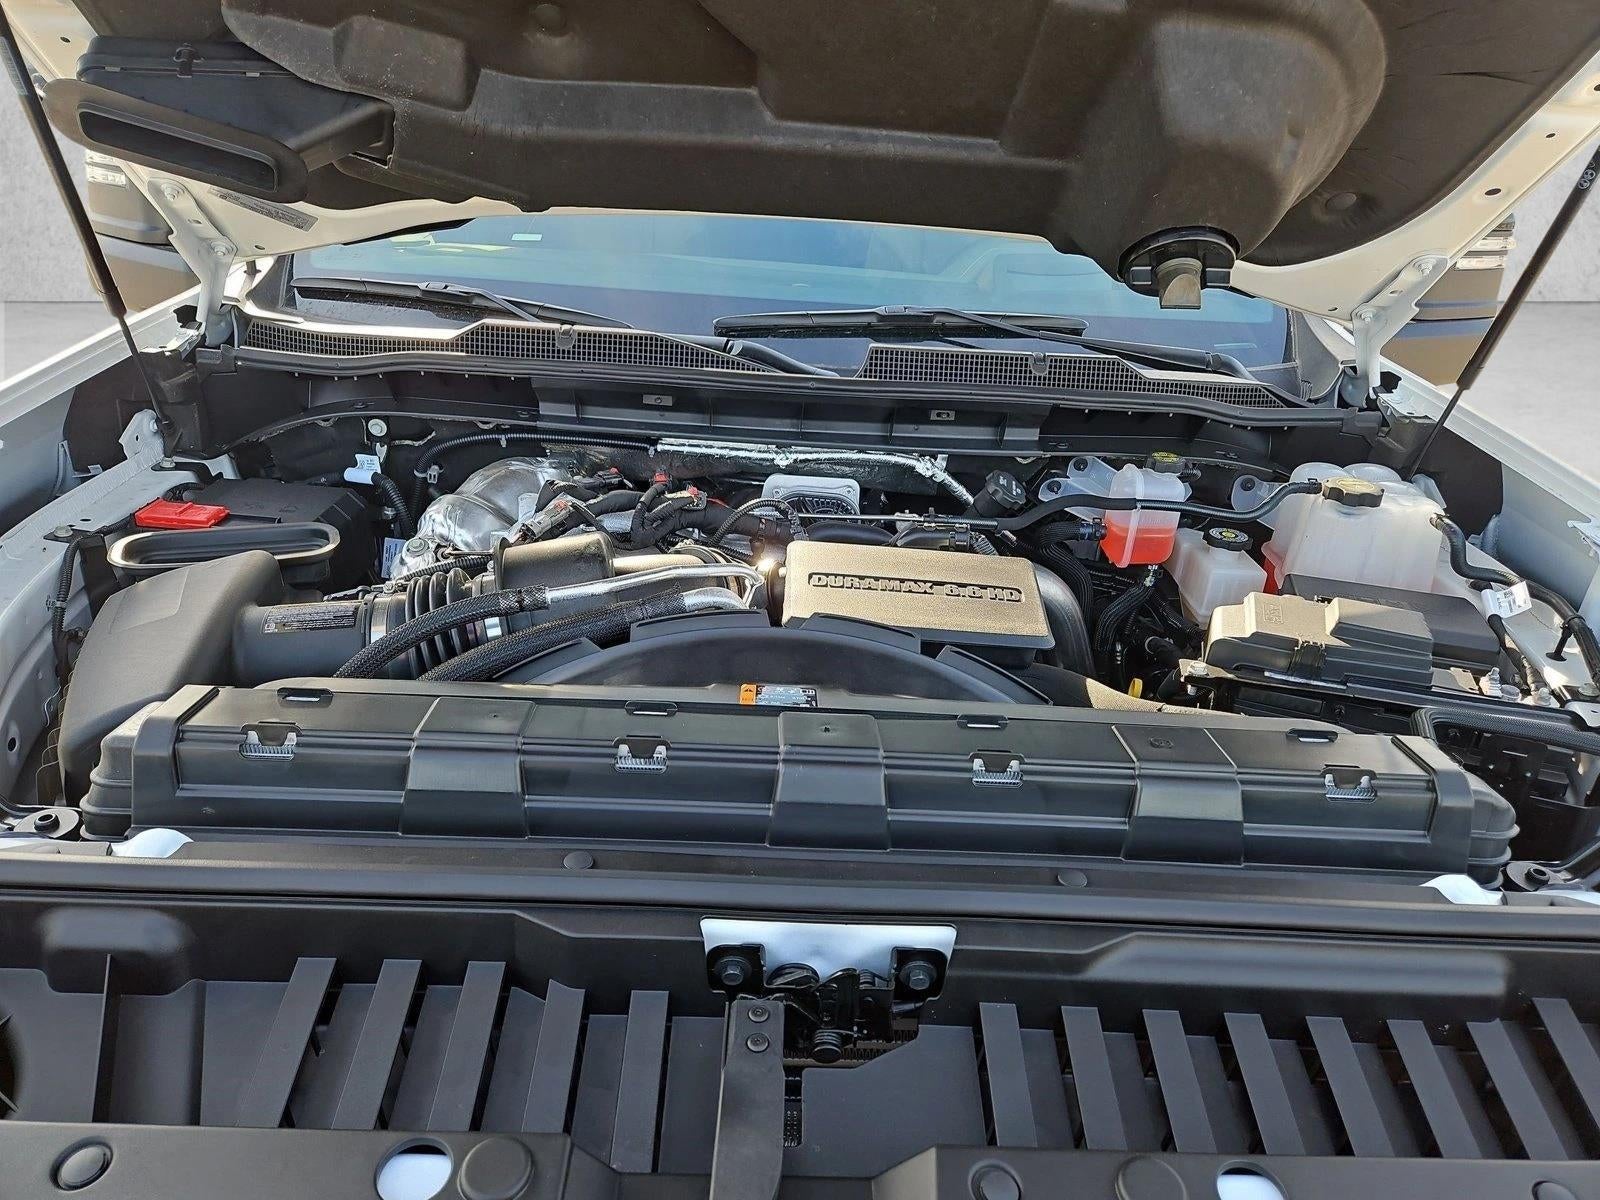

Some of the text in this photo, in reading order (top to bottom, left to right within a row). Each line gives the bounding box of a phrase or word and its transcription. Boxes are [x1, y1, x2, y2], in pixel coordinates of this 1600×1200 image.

[811, 574, 1023, 602] DURAMAX 6.6 HD
